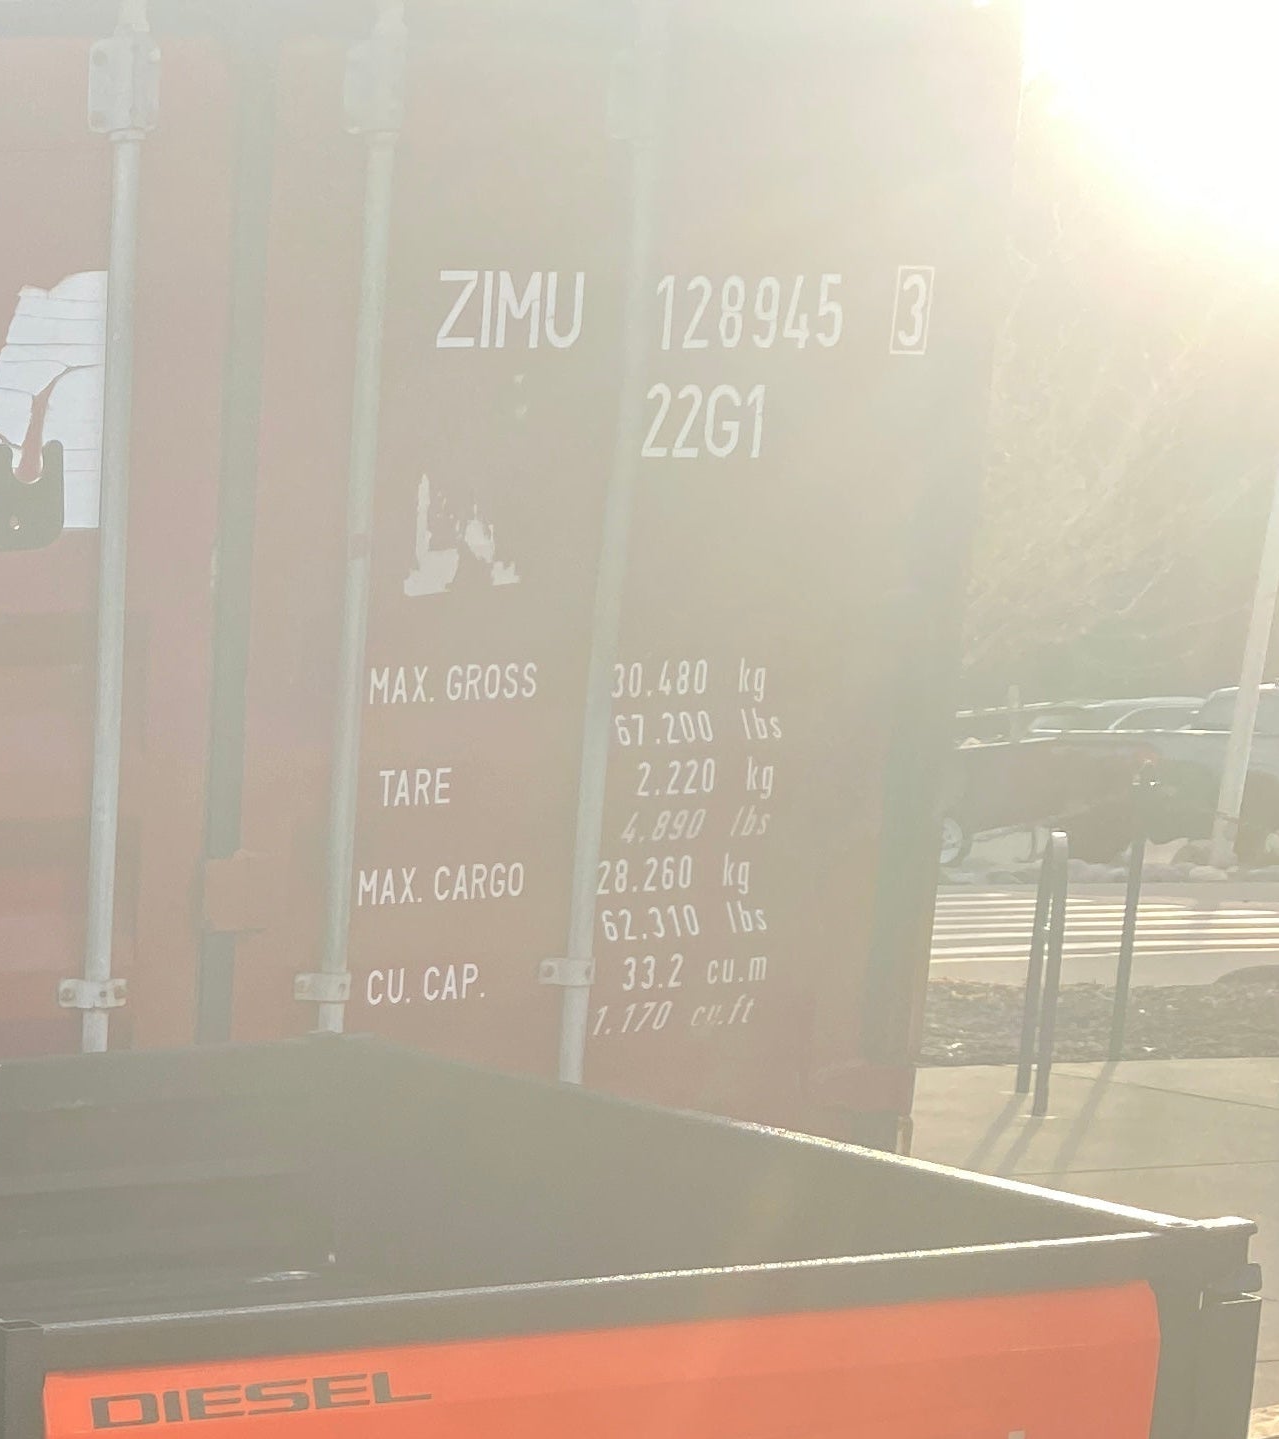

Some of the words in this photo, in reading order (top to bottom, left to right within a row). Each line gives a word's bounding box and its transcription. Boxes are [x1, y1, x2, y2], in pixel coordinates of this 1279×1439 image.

[436, 270, 585, 349] ZIMU
[655, 273, 844, 351] 128945
[899, 279, 926, 346] 3
[641, 383, 765, 458] 22G1
[369, 666, 435, 704] MAX.
[446, 662, 538, 701] GROSS
[611, 659, 709, 699] 30.480
[738, 657, 767, 702] kg
[614, 711, 713, 747] 67.200
[740, 707, 782, 741] lbs
[379, 768, 452, 807] TARE
[636, 758, 716, 797] 2.220
[746, 756, 774, 800] kg
[620, 808, 707, 844] 4.890
[729, 805, 771, 837] lbs
[358, 867, 423, 906] MAX.
[434, 862, 525, 901] CARGO
[596, 855, 693, 895] 28.260
[722, 853, 751, 895] kg
[602, 904, 700, 942] 62.310
[725, 901, 768, 934] lbs
[366, 968, 411, 1006] CU.
[423, 963, 486, 1001] CAP.
[622, 953, 685, 991] 33.2
[706, 955, 768, 985] cu.m
[90, 1371, 433, 1430] DIESEL
